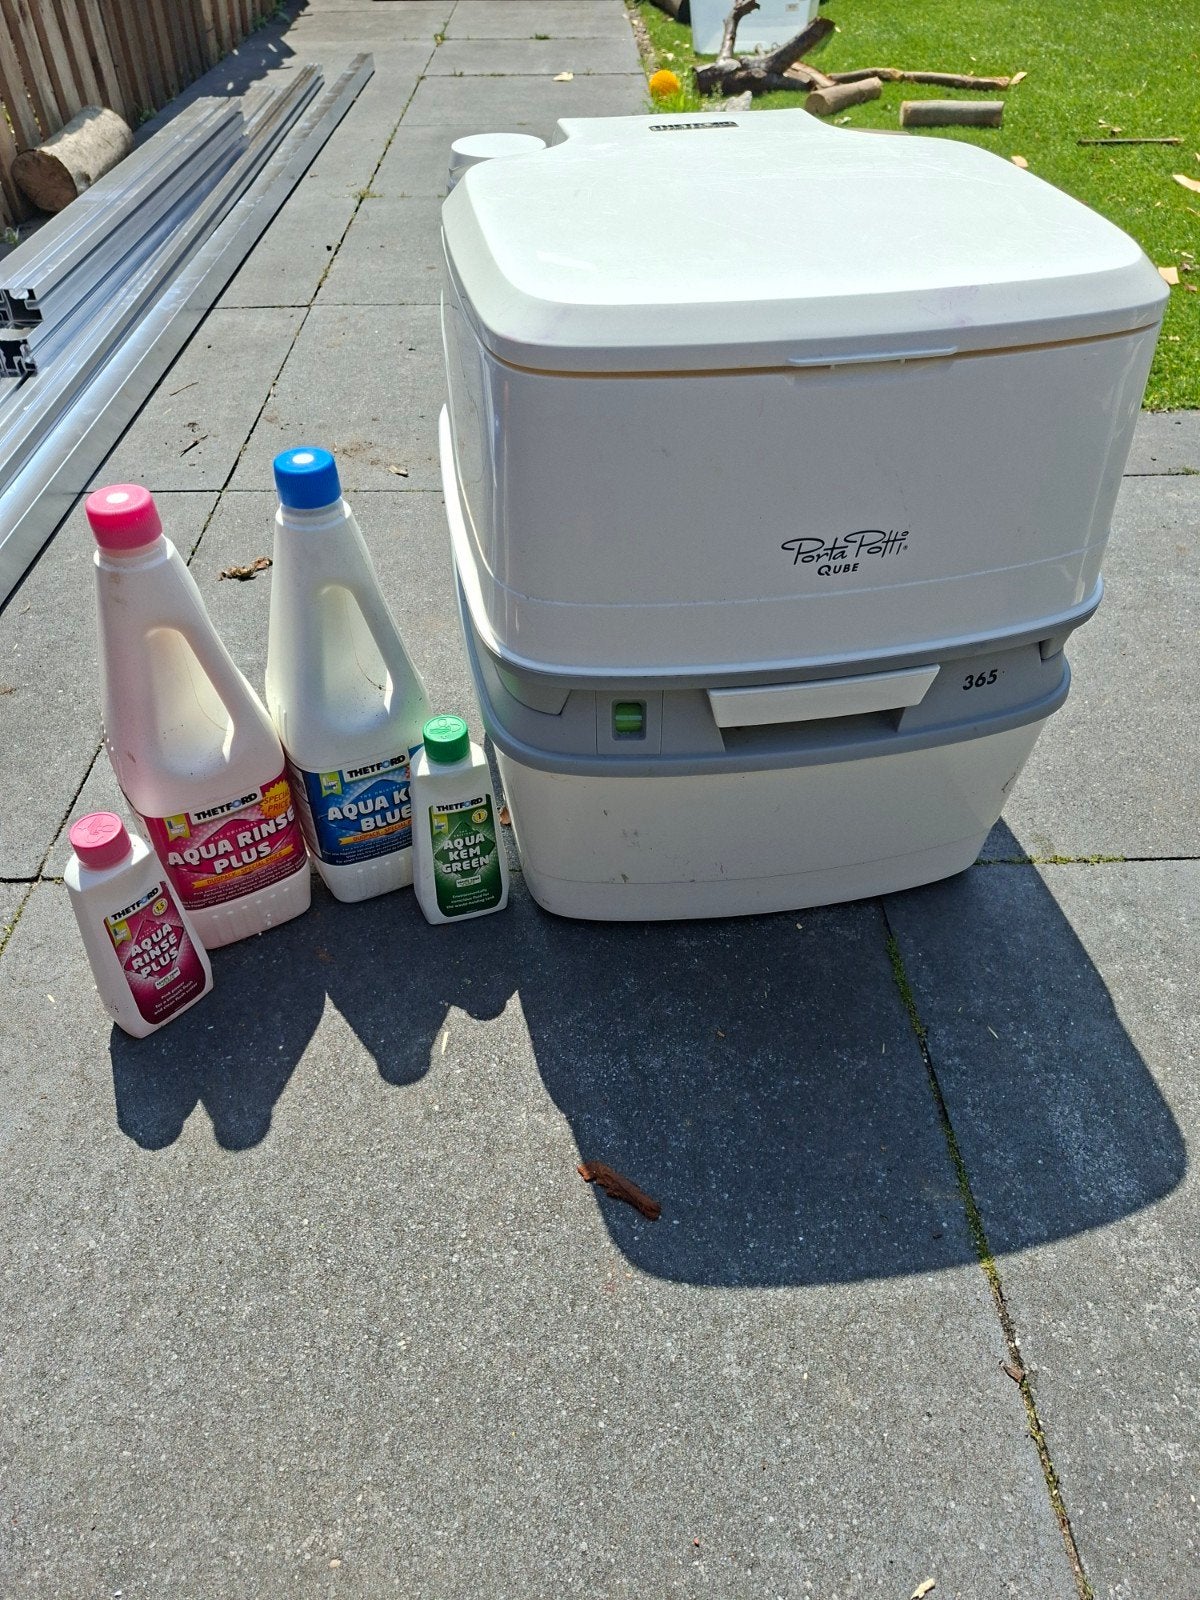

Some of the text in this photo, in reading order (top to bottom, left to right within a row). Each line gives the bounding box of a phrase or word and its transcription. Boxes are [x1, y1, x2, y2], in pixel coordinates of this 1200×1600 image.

[781, 537, 848, 566] Porta
[817, 562, 860, 577] QUBE
[962, 669, 998, 691] 365
[346, 754, 406, 779] THETFORD
[194, 792, 258, 821] THETFORD
[327, 795, 389, 821] AQUA
[360, 803, 412, 832] BLUE
[436, 797, 483, 812] THETFORD
[168, 838, 233, 866] AQUA
[236, 805, 295, 848] RINSE
[443, 833, 485, 850] AQUA
[213, 841, 272, 875] PLUS
[441, 855, 490, 874] GREEN
[448, 845, 480, 861] KEM
[111, 887, 159, 921] THETFORD
[130, 923, 173, 957] AQUA
[131, 932, 178, 970] RINSE
[140, 946, 179, 979] PLUS
